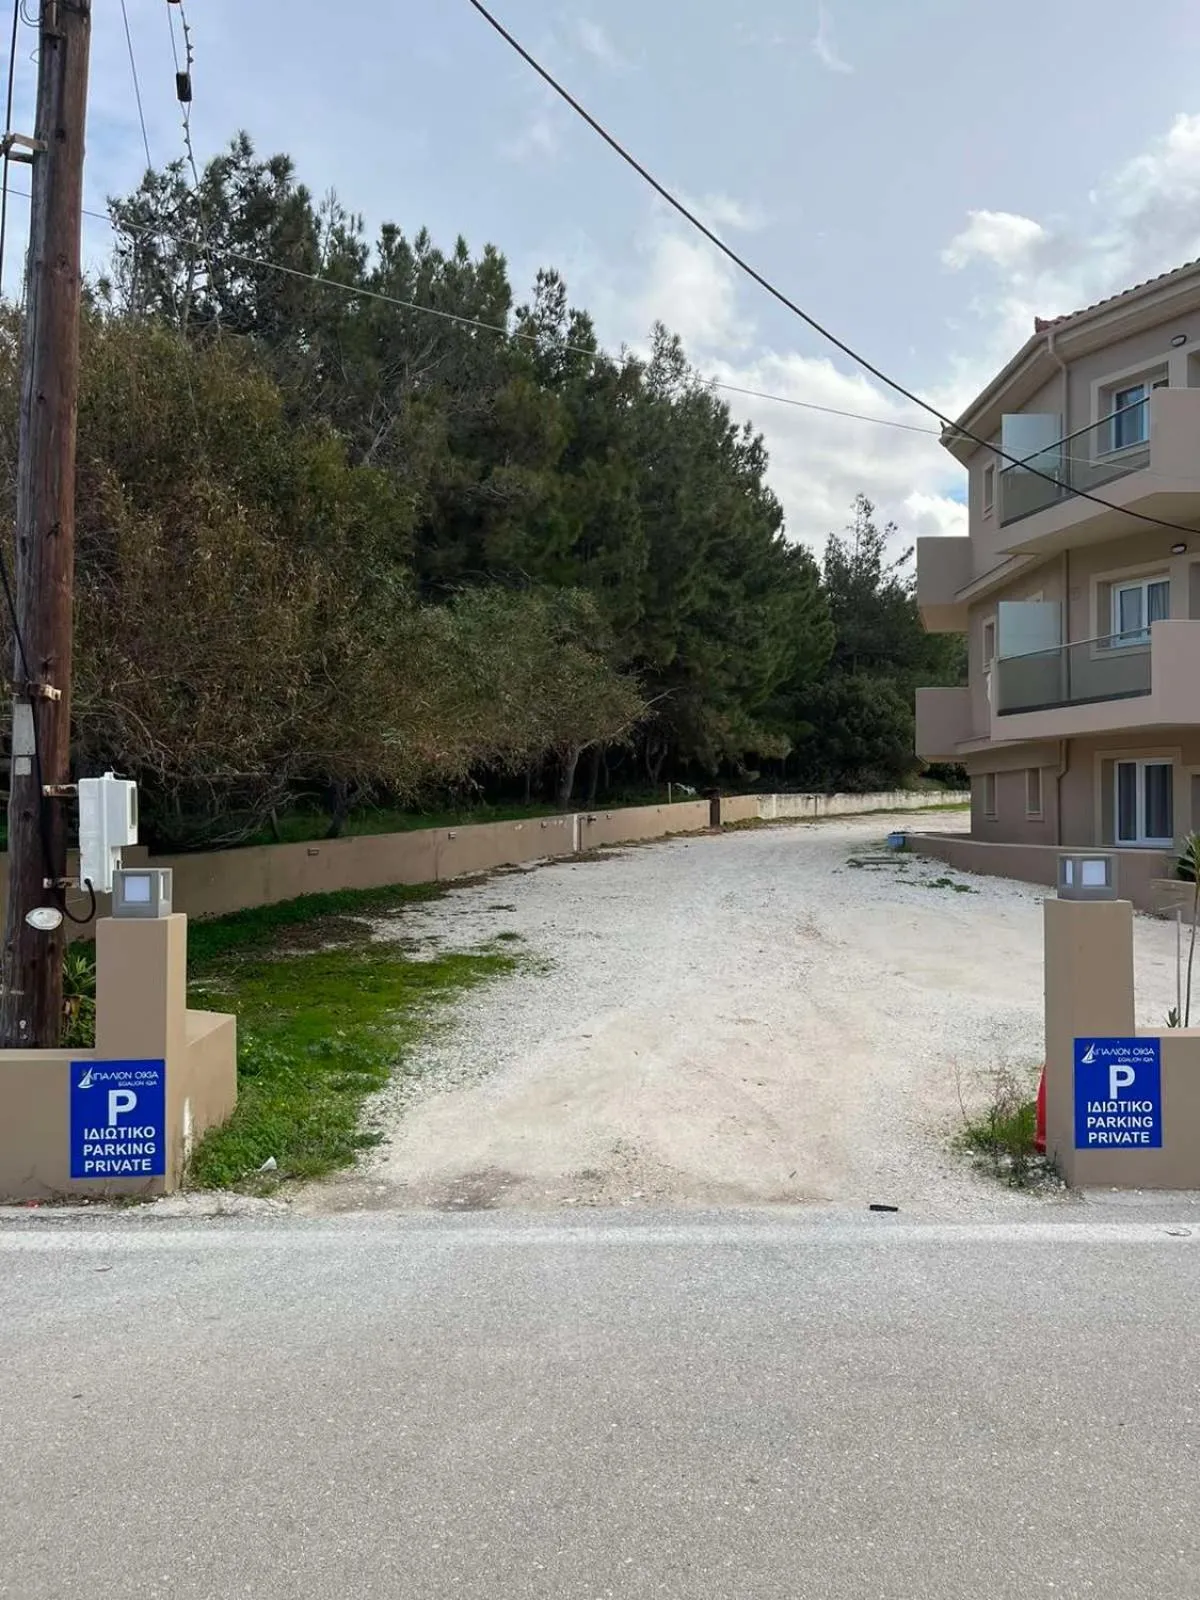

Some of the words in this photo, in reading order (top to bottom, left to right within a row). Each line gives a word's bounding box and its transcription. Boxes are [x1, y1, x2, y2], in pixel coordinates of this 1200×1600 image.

[1109, 1065, 1136, 1100] P
[108, 1089, 137, 1126] P
[1087, 1101, 1153, 1113] ΙΔΙΩΤΙΚΟ
[1087, 1116, 1153, 1128] PARKING
[84, 1126, 156, 1140] ΙΔΙΩΤΙΚΟ
[1088, 1131, 1150, 1144] PRIVATE
[83, 1142, 156, 1156] PARKING
[84, 1158, 152, 1172] PRIVATE
